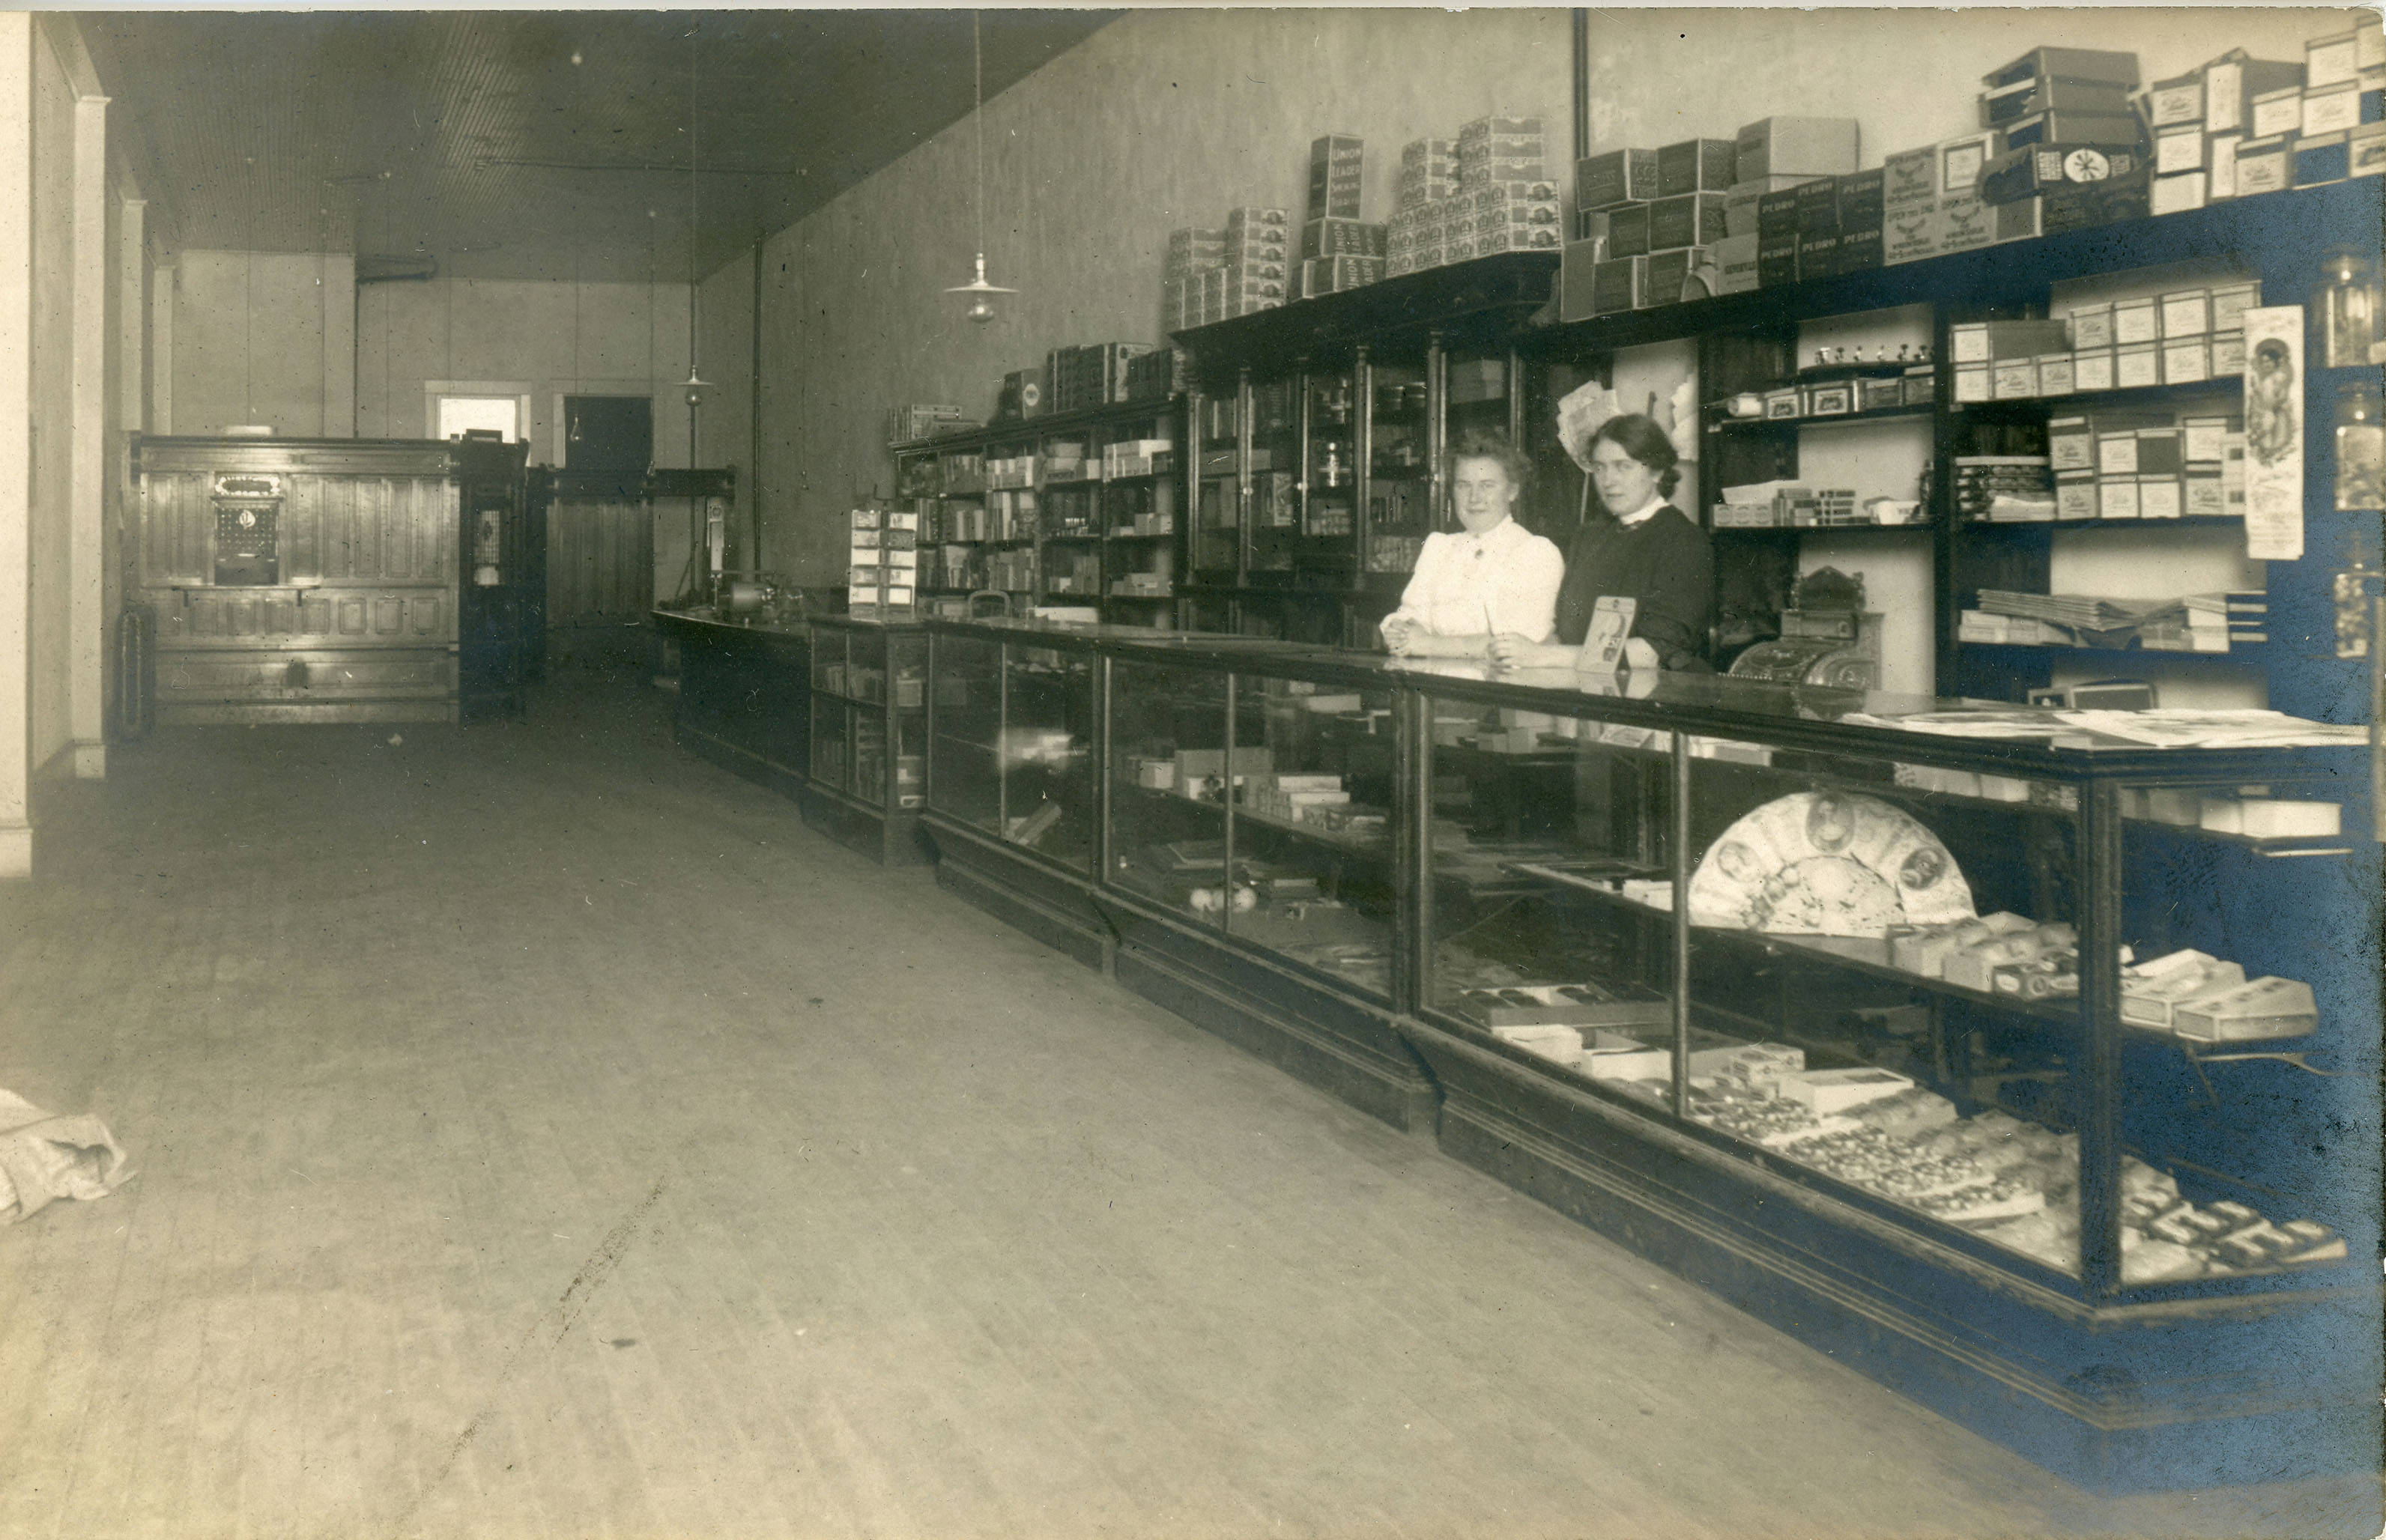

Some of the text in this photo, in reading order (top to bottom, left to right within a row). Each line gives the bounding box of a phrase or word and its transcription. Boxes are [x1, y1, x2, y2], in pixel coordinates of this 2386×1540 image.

[1332, 148, 1361, 160] UNION
[1331, 164, 1361, 178] LEADER
[1799, 182, 1833, 195] PEDRO
[1762, 200, 1795, 213] PEDRO
[1333, 223, 1347, 254] UNION
[1844, 230, 1880, 244] PEDRO
[1802, 237, 1837, 252] PEDRO
[1362, 260, 1374, 282] ADER
